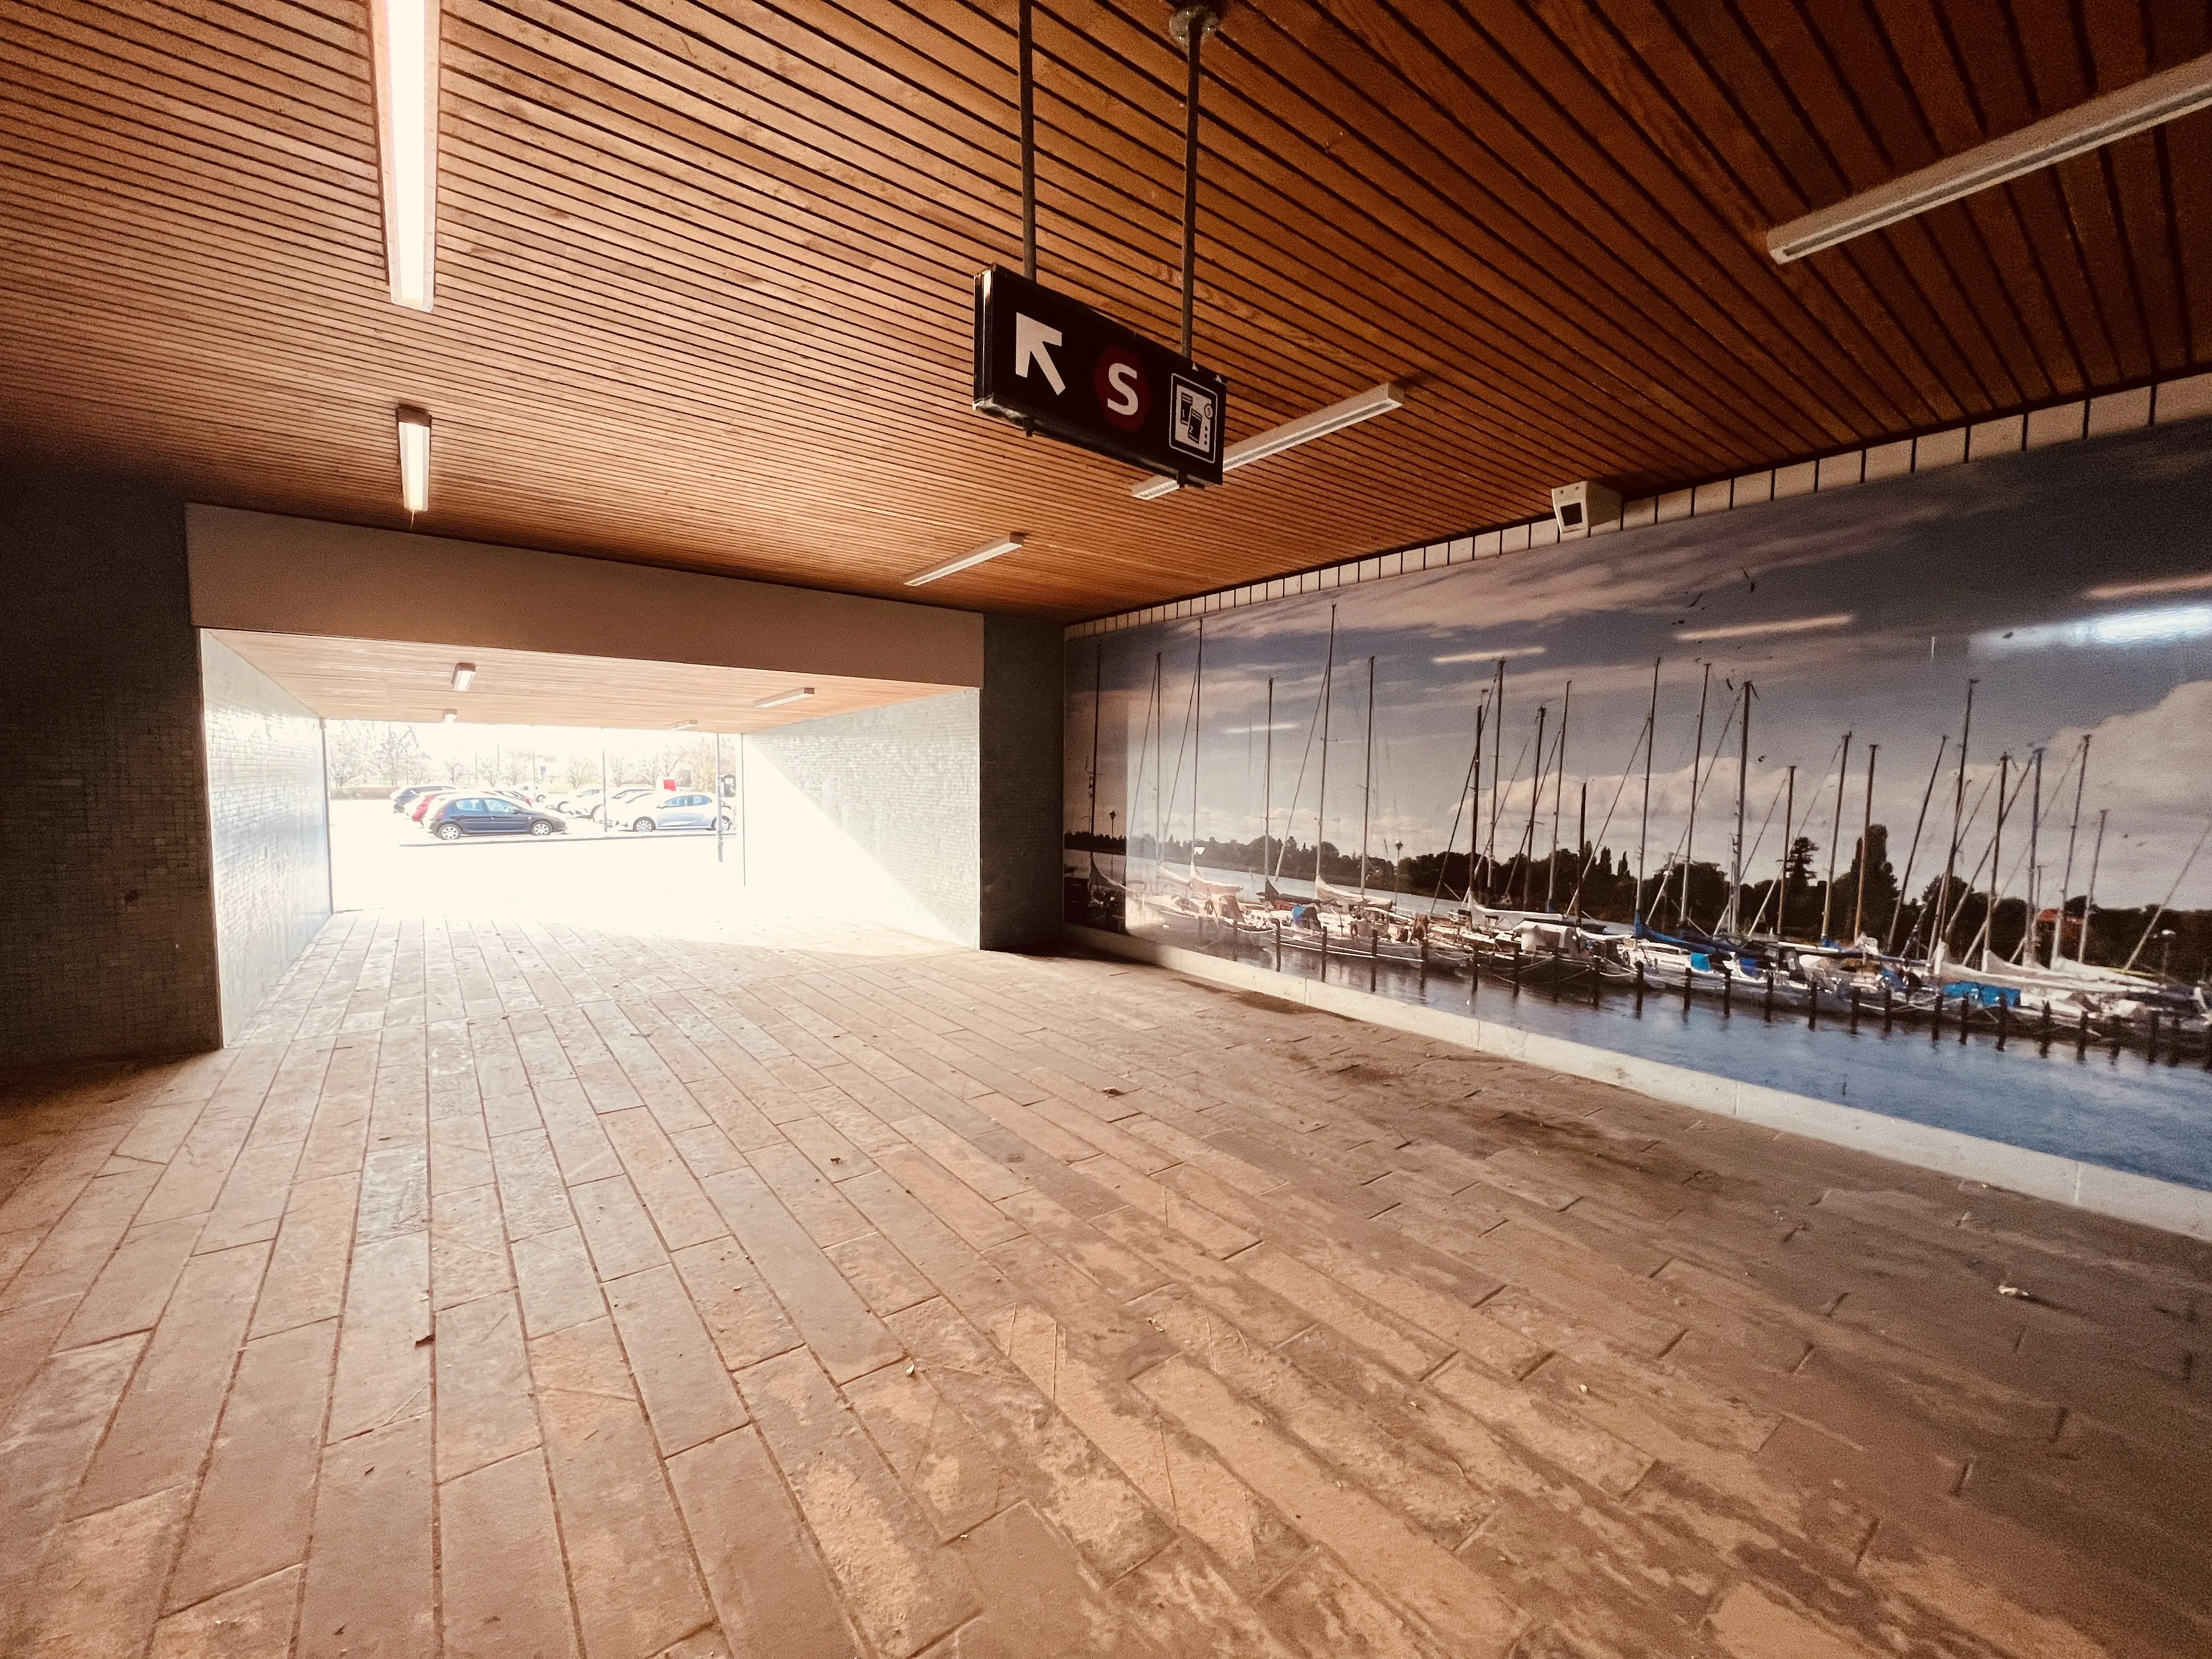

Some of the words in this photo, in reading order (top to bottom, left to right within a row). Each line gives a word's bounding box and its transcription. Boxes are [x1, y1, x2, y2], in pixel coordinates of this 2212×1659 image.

[1108, 363, 1138, 415] S
[1182, 409, 1185, 417] 1
[1189, 425, 1193, 434] 2
